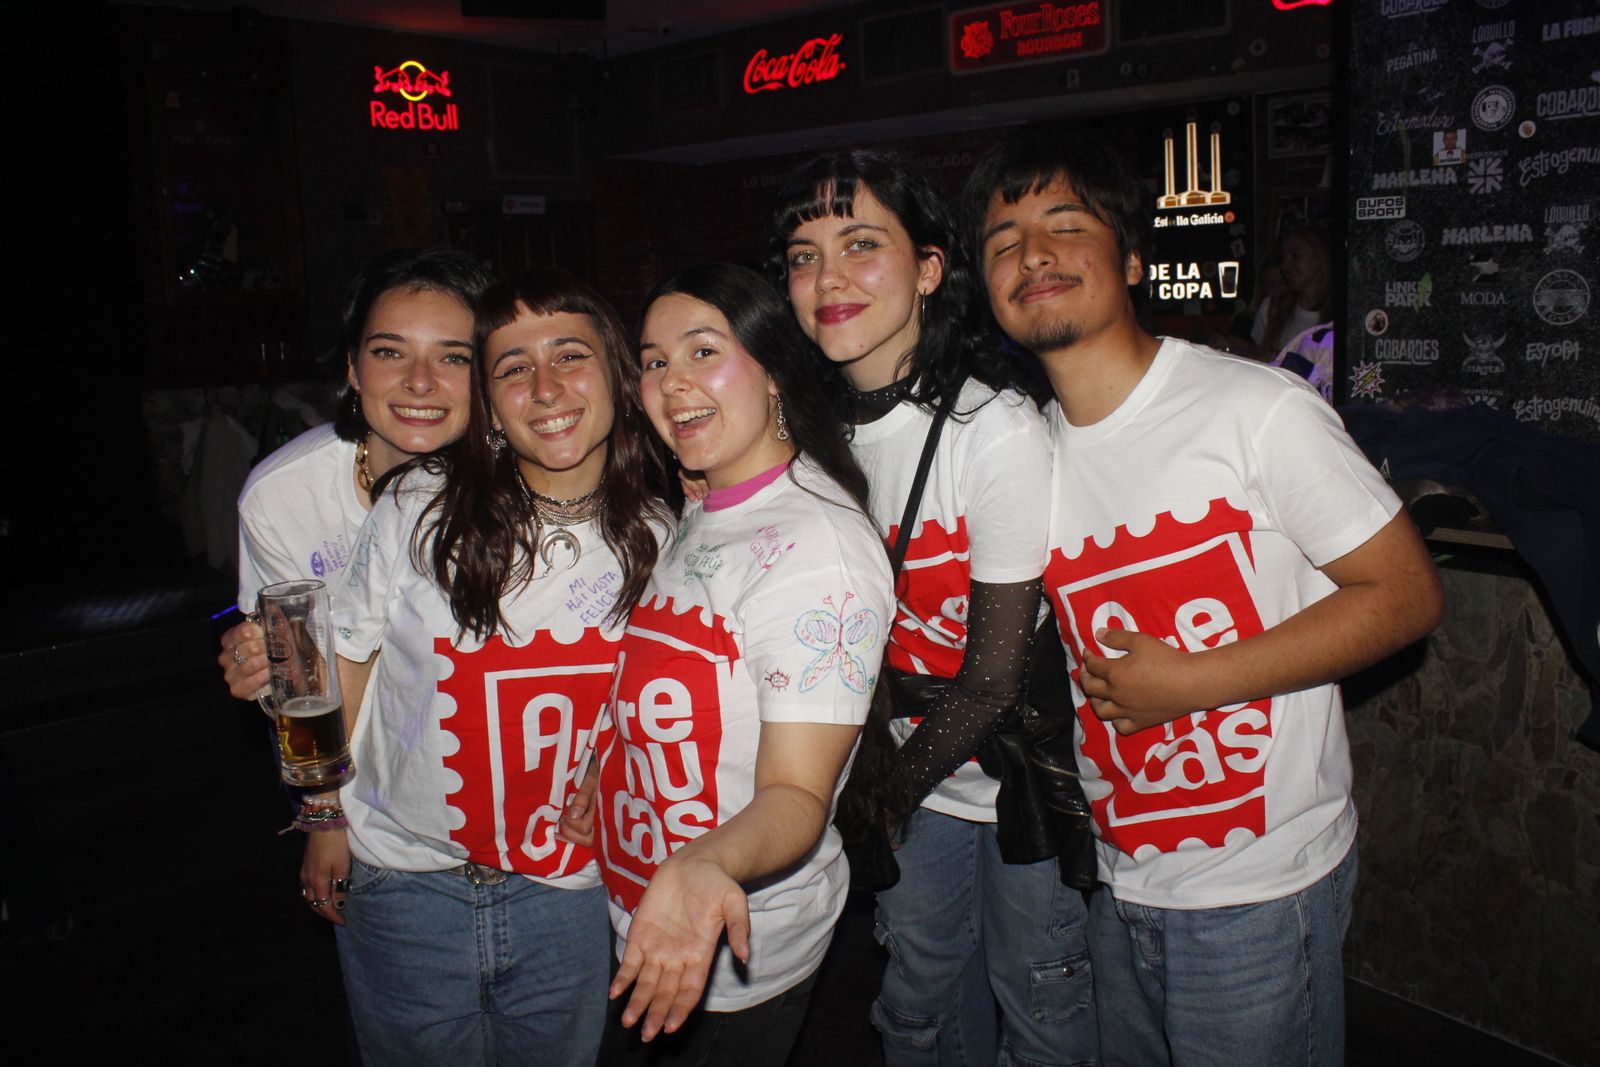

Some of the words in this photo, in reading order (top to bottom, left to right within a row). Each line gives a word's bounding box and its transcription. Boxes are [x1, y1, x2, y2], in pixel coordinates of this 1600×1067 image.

[1040, 2, 1101, 32] Roses
[1542, 22, 1560, 41] LA
[1016, 31, 1084, 56] BOURBON
[1386, 47, 1438, 73] PEGATINA
[370, 99, 415, 129] Red
[417, 102, 460, 132] Bull
[1358, 198, 1404, 208] BUFOS
[1358, 207, 1404, 217] SPORT
[1153, 215, 1189, 228] Estlla
[1190, 213, 1224, 226] Galicia
[1441, 224, 1534, 246] MARLENA
[1176, 263, 1201, 280] LA
[1158, 282, 1213, 300] COPA
[1376, 339, 1440, 366] COBARDES
[1526, 340, 1584, 368] ESTOPA
[569, 578, 586, 594] MI
[617, 677, 694, 744] re
[1130, 707, 1273, 795] cas
